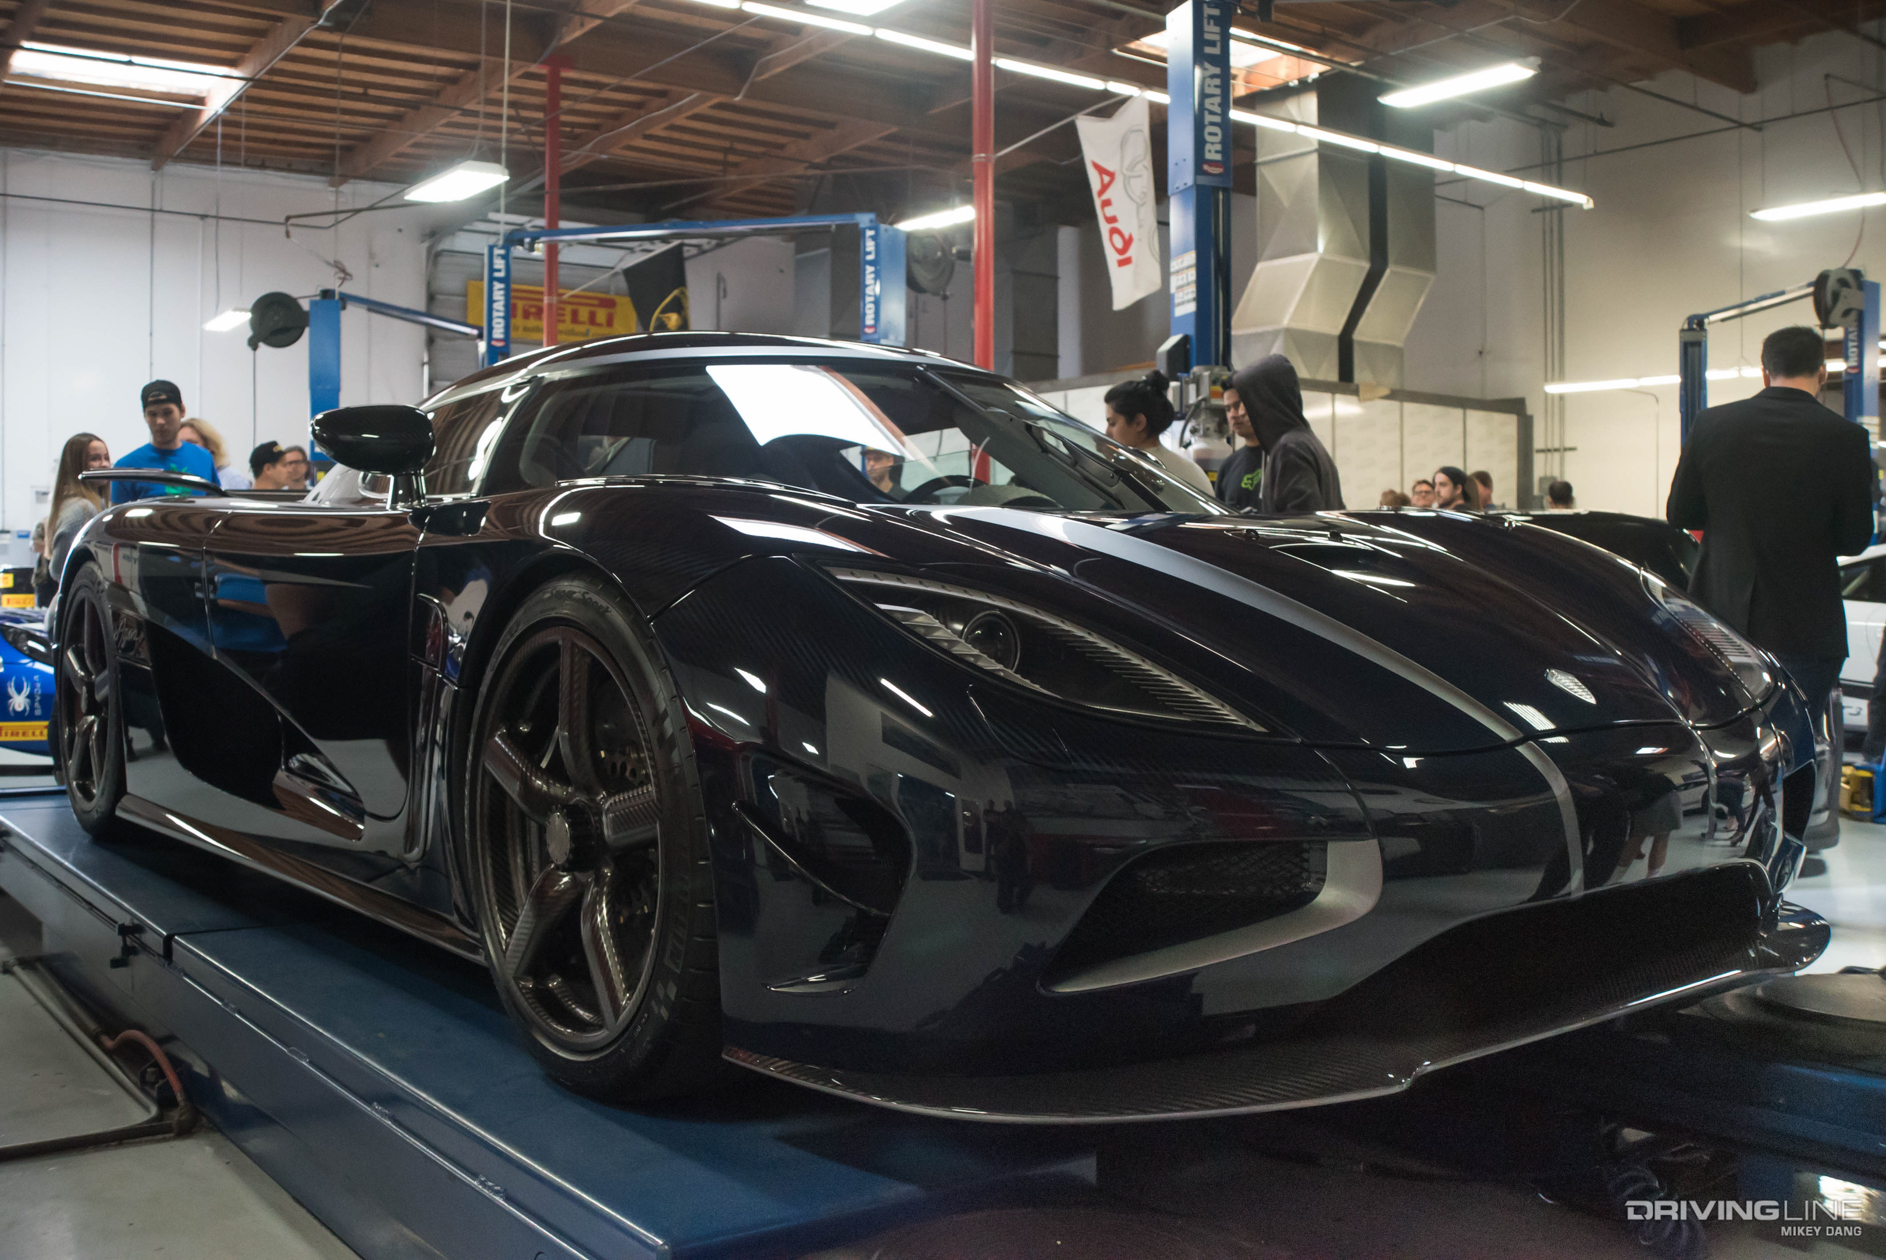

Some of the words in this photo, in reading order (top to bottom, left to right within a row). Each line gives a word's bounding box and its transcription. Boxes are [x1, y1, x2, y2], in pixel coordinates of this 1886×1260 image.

[1203, 3, 1222, 55] LIFT
[1203, 60, 1223, 161] ROTARY
[1091, 160, 1134, 268] Audi
[492, 247, 506, 277] LIFT
[865, 229, 876, 260] LIFT
[492, 281, 506, 339] ROTARY
[864, 264, 876, 326] ROTARY
